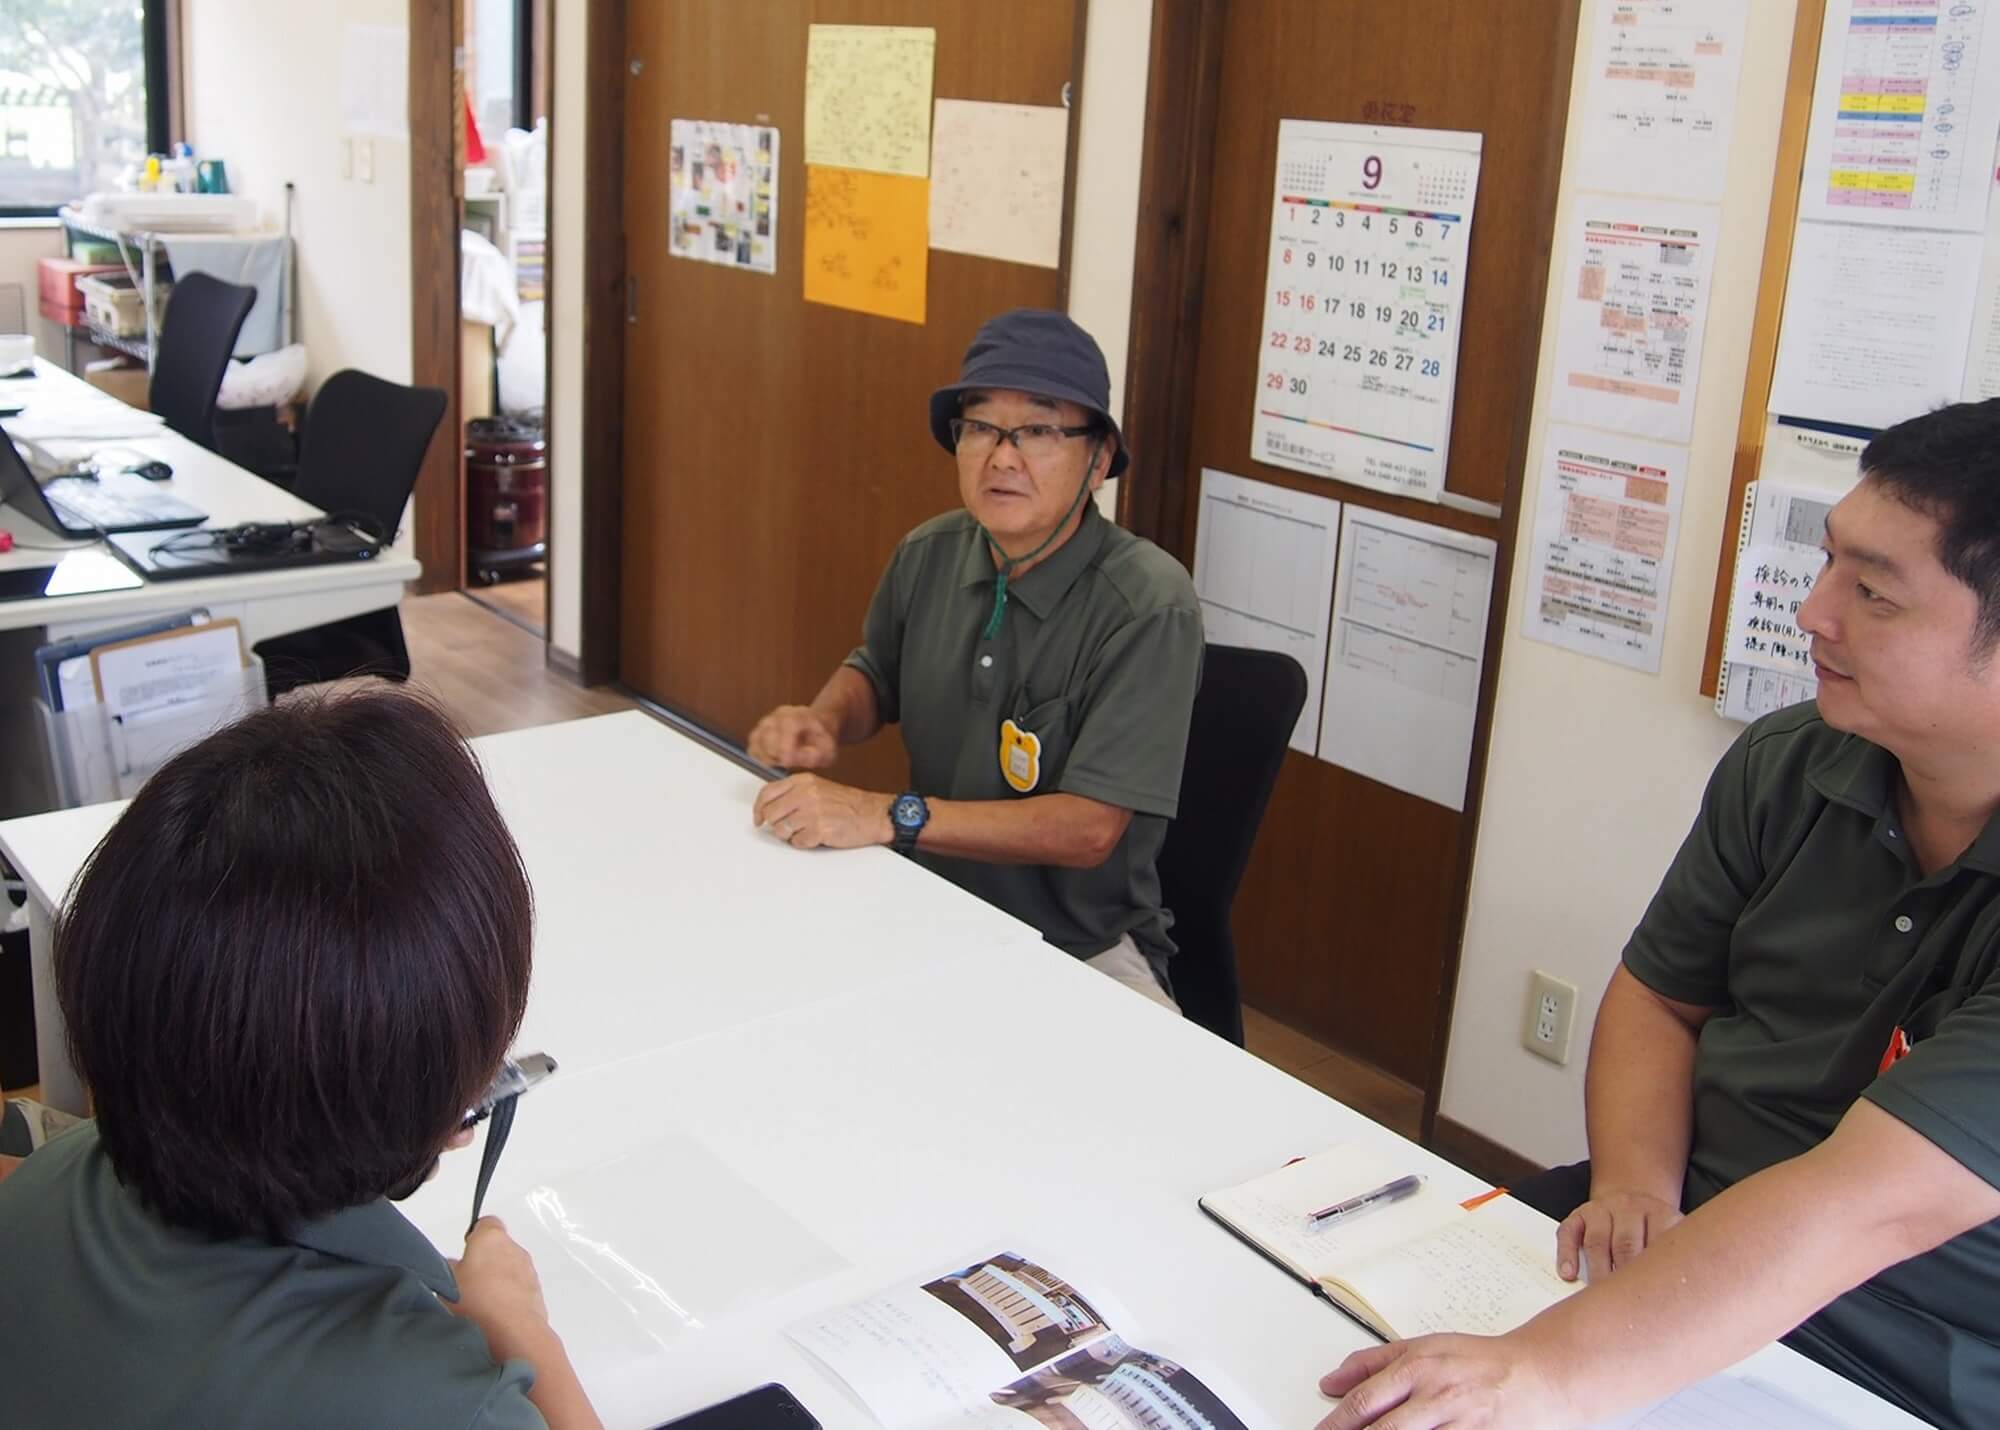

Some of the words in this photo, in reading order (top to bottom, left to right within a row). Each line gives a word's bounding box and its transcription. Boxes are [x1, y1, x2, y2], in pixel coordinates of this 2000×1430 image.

[1362, 156, 1382, 190] 9
[1288, 206, 1296, 222] 1
[1311, 209, 1320, 225] 2
[1335, 212, 1344, 229] 3
[1361, 216, 1370, 231] 4
[1388, 218, 1398, 235] 5
[1414, 221, 1423, 238] 6
[1440, 224, 1450, 241] 7
[1282, 249, 1291, 265] 8
[1306, 252, 1315, 268] 9
[1328, 256, 1344, 272] 10
[1354, 259, 1368, 275] 11
[1380, 262, 1397, 280] 12
[1407, 266, 1422, 284] 13
[1432, 270, 1447, 287] 14
[1276, 291, 1290, 307] 15
[1299, 295, 1314, 312] 16
[1324, 298, 1340, 314] 17
[1349, 303, 1365, 320] 18
[1375, 307, 1392, 323] 19
[1399, 310, 1419, 330] 20
[1426, 315, 1444, 332] 21
[1270, 332, 1287, 349] 22
[1293, 336, 1311, 354] 23
[1317, 341, 1335, 358] 24
[1343, 345, 1361, 363] 25
[1368, 350, 1387, 367] 26
[1394, 354, 1414, 372] 27
[1420, 359, 1440, 377] 28
[1266, 373, 1283, 391] 29
[1289, 378, 1307, 396] 30
